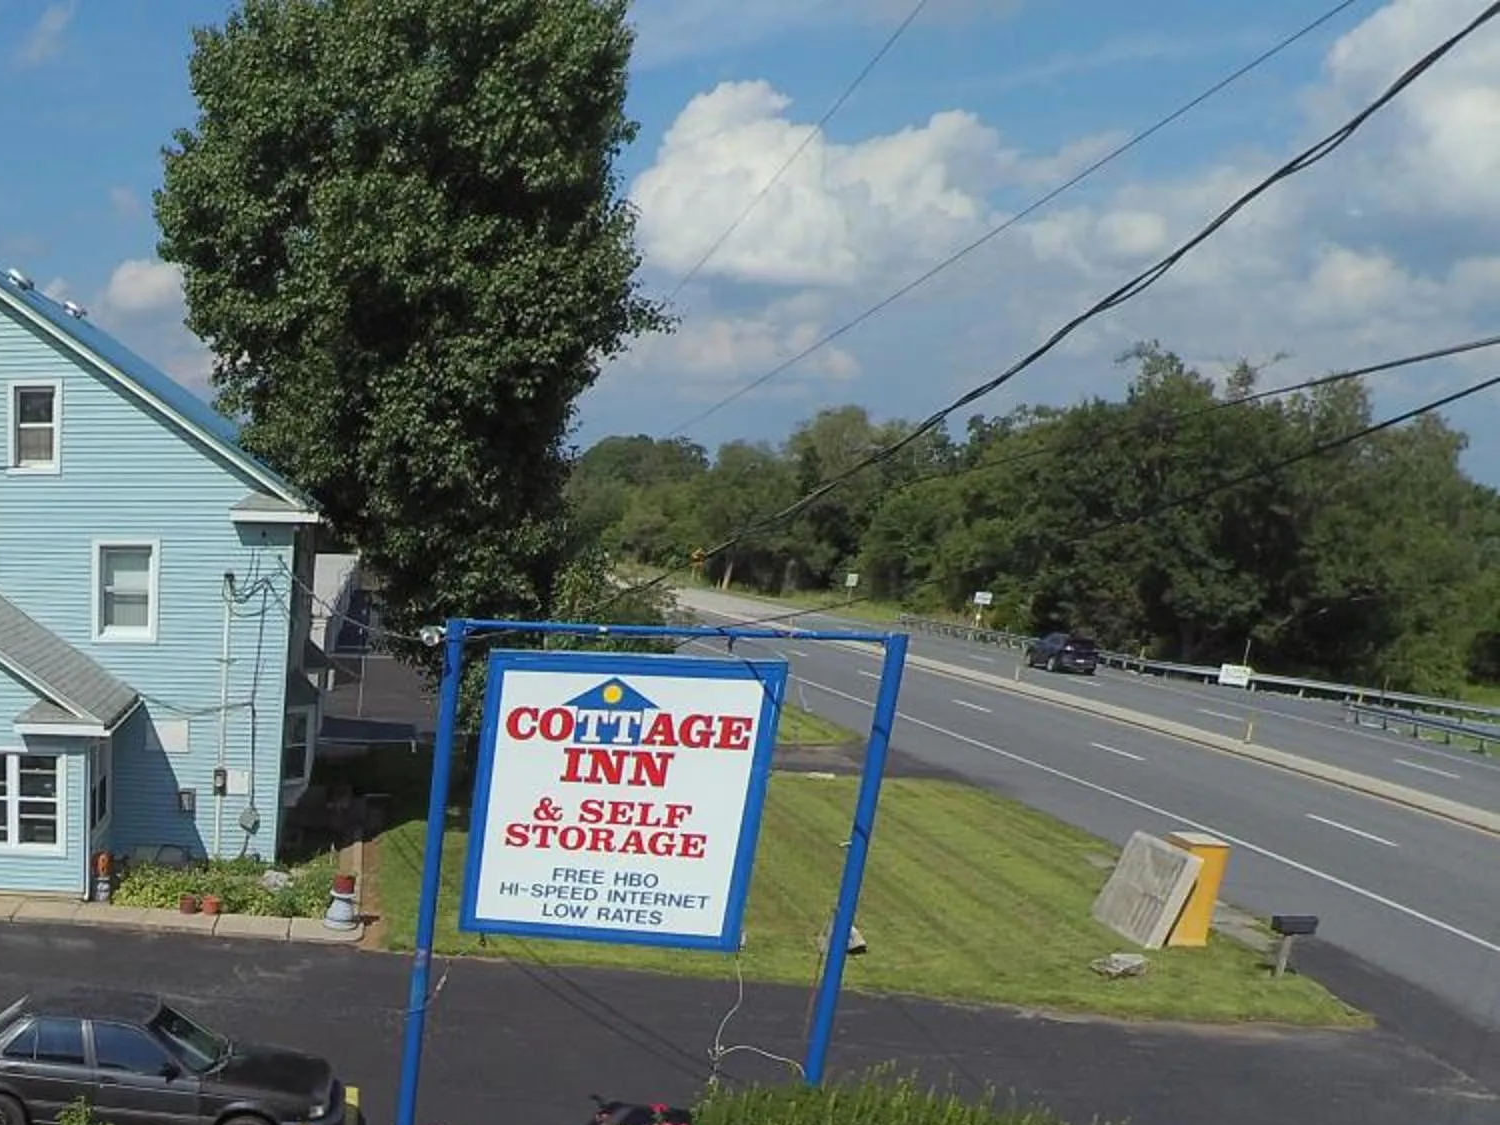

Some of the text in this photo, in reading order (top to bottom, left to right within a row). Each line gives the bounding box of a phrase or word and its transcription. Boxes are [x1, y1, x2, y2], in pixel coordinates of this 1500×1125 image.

[505, 706, 754, 751] COTTAGE
[560, 746, 676, 788] INN
[533, 796, 694, 829] & SELF
[504, 823, 708, 859] STORAGE
[551, 867, 659, 889] FREE HBO
[499, 881, 711, 910] HI-SPEED INTERNET
[541, 903, 664, 926] LOW RATES
